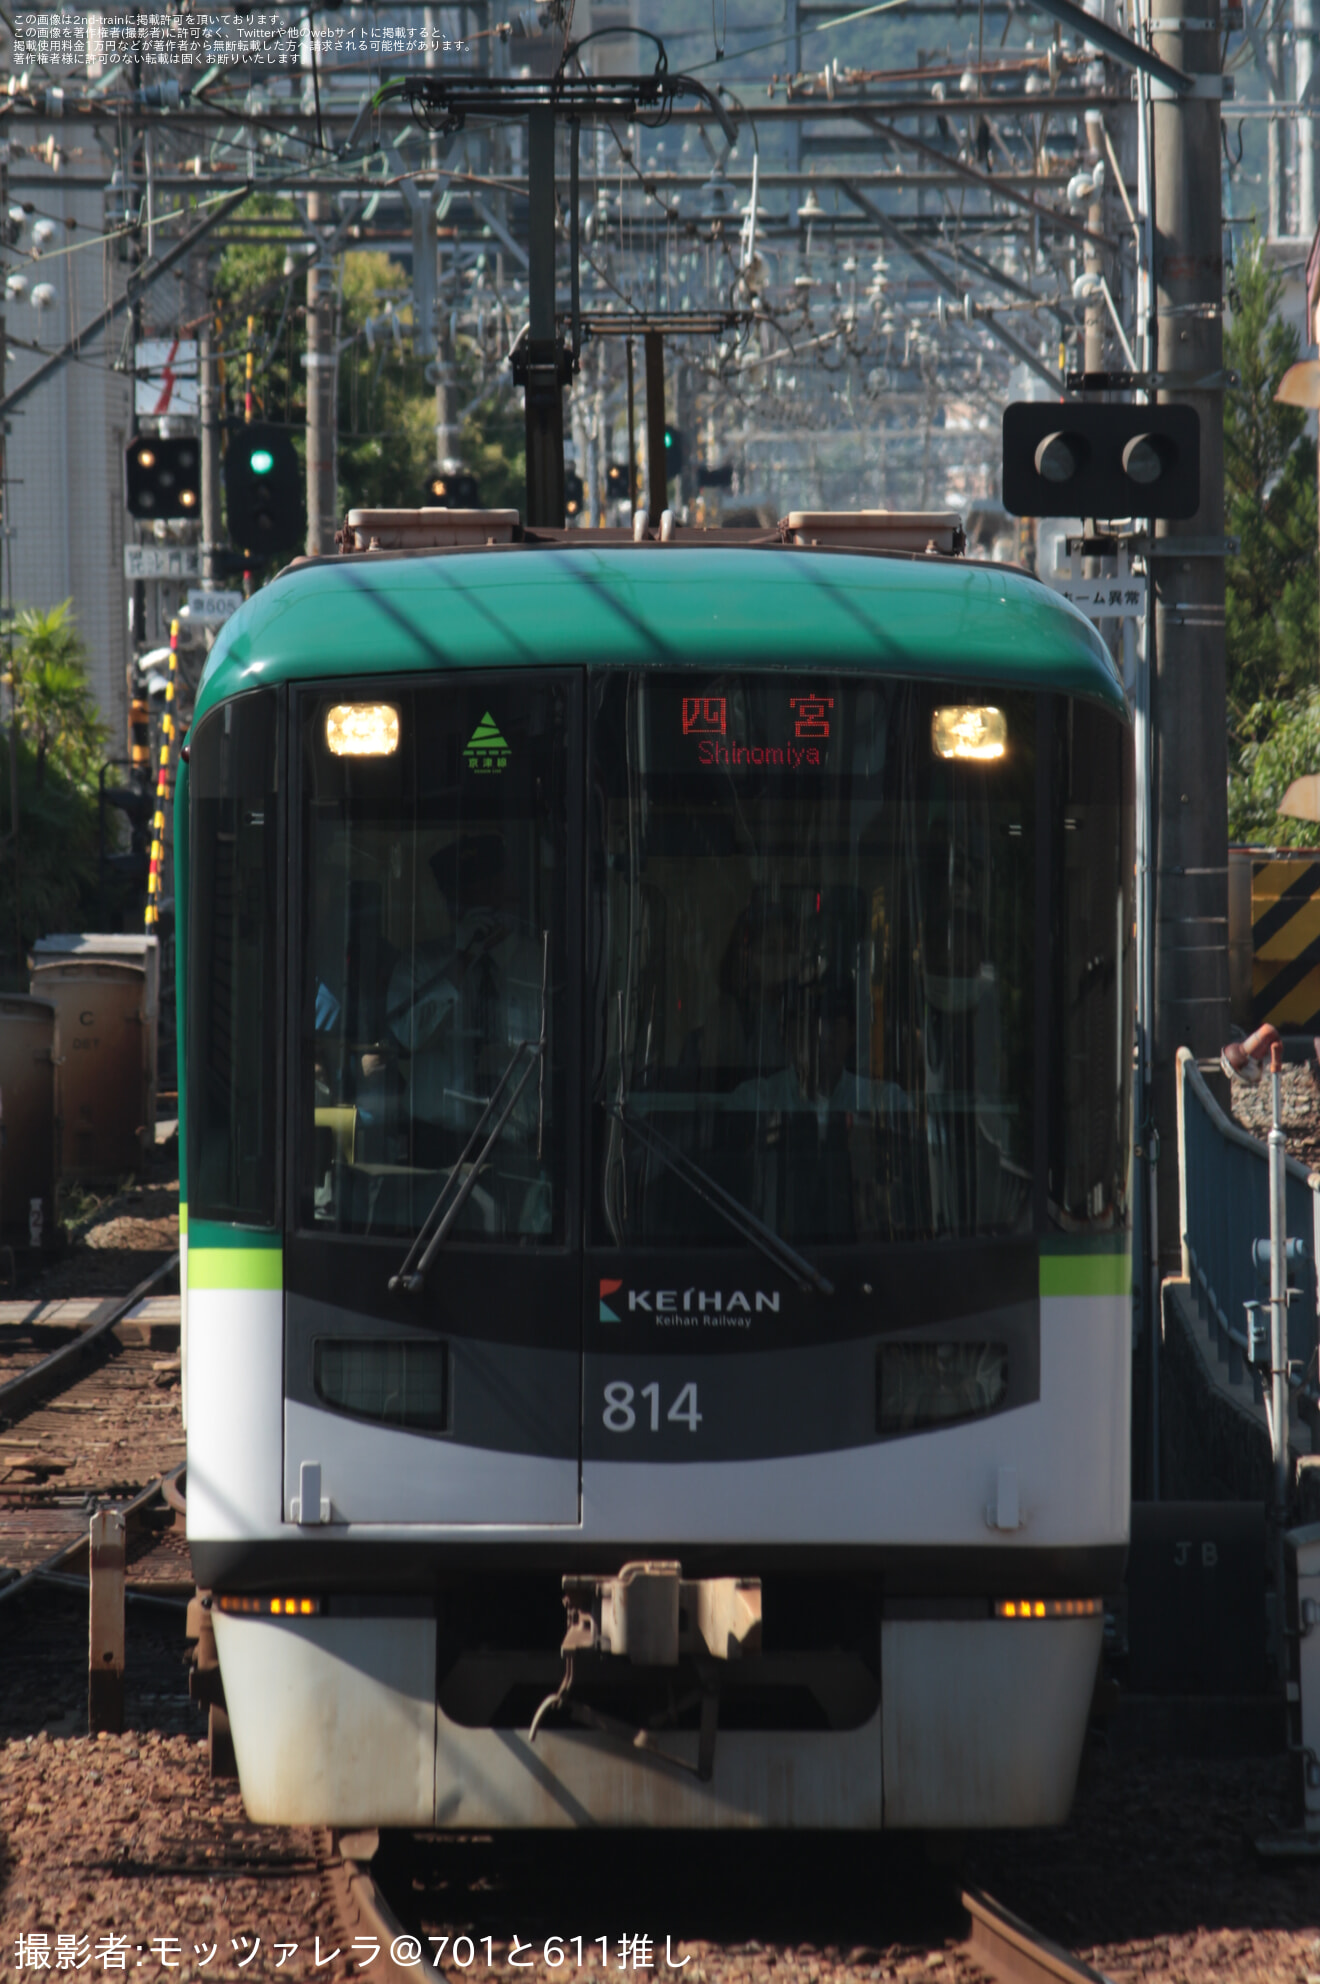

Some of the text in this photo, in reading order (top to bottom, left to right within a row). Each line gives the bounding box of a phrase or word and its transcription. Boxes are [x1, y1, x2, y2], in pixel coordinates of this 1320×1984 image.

[698, 740, 820, 769] Shinomiya
[628, 1287, 781, 1312] KEIHAN
[655, 1315, 752, 1329] Keihan Railway
[602, 1381, 703, 1432] 814
